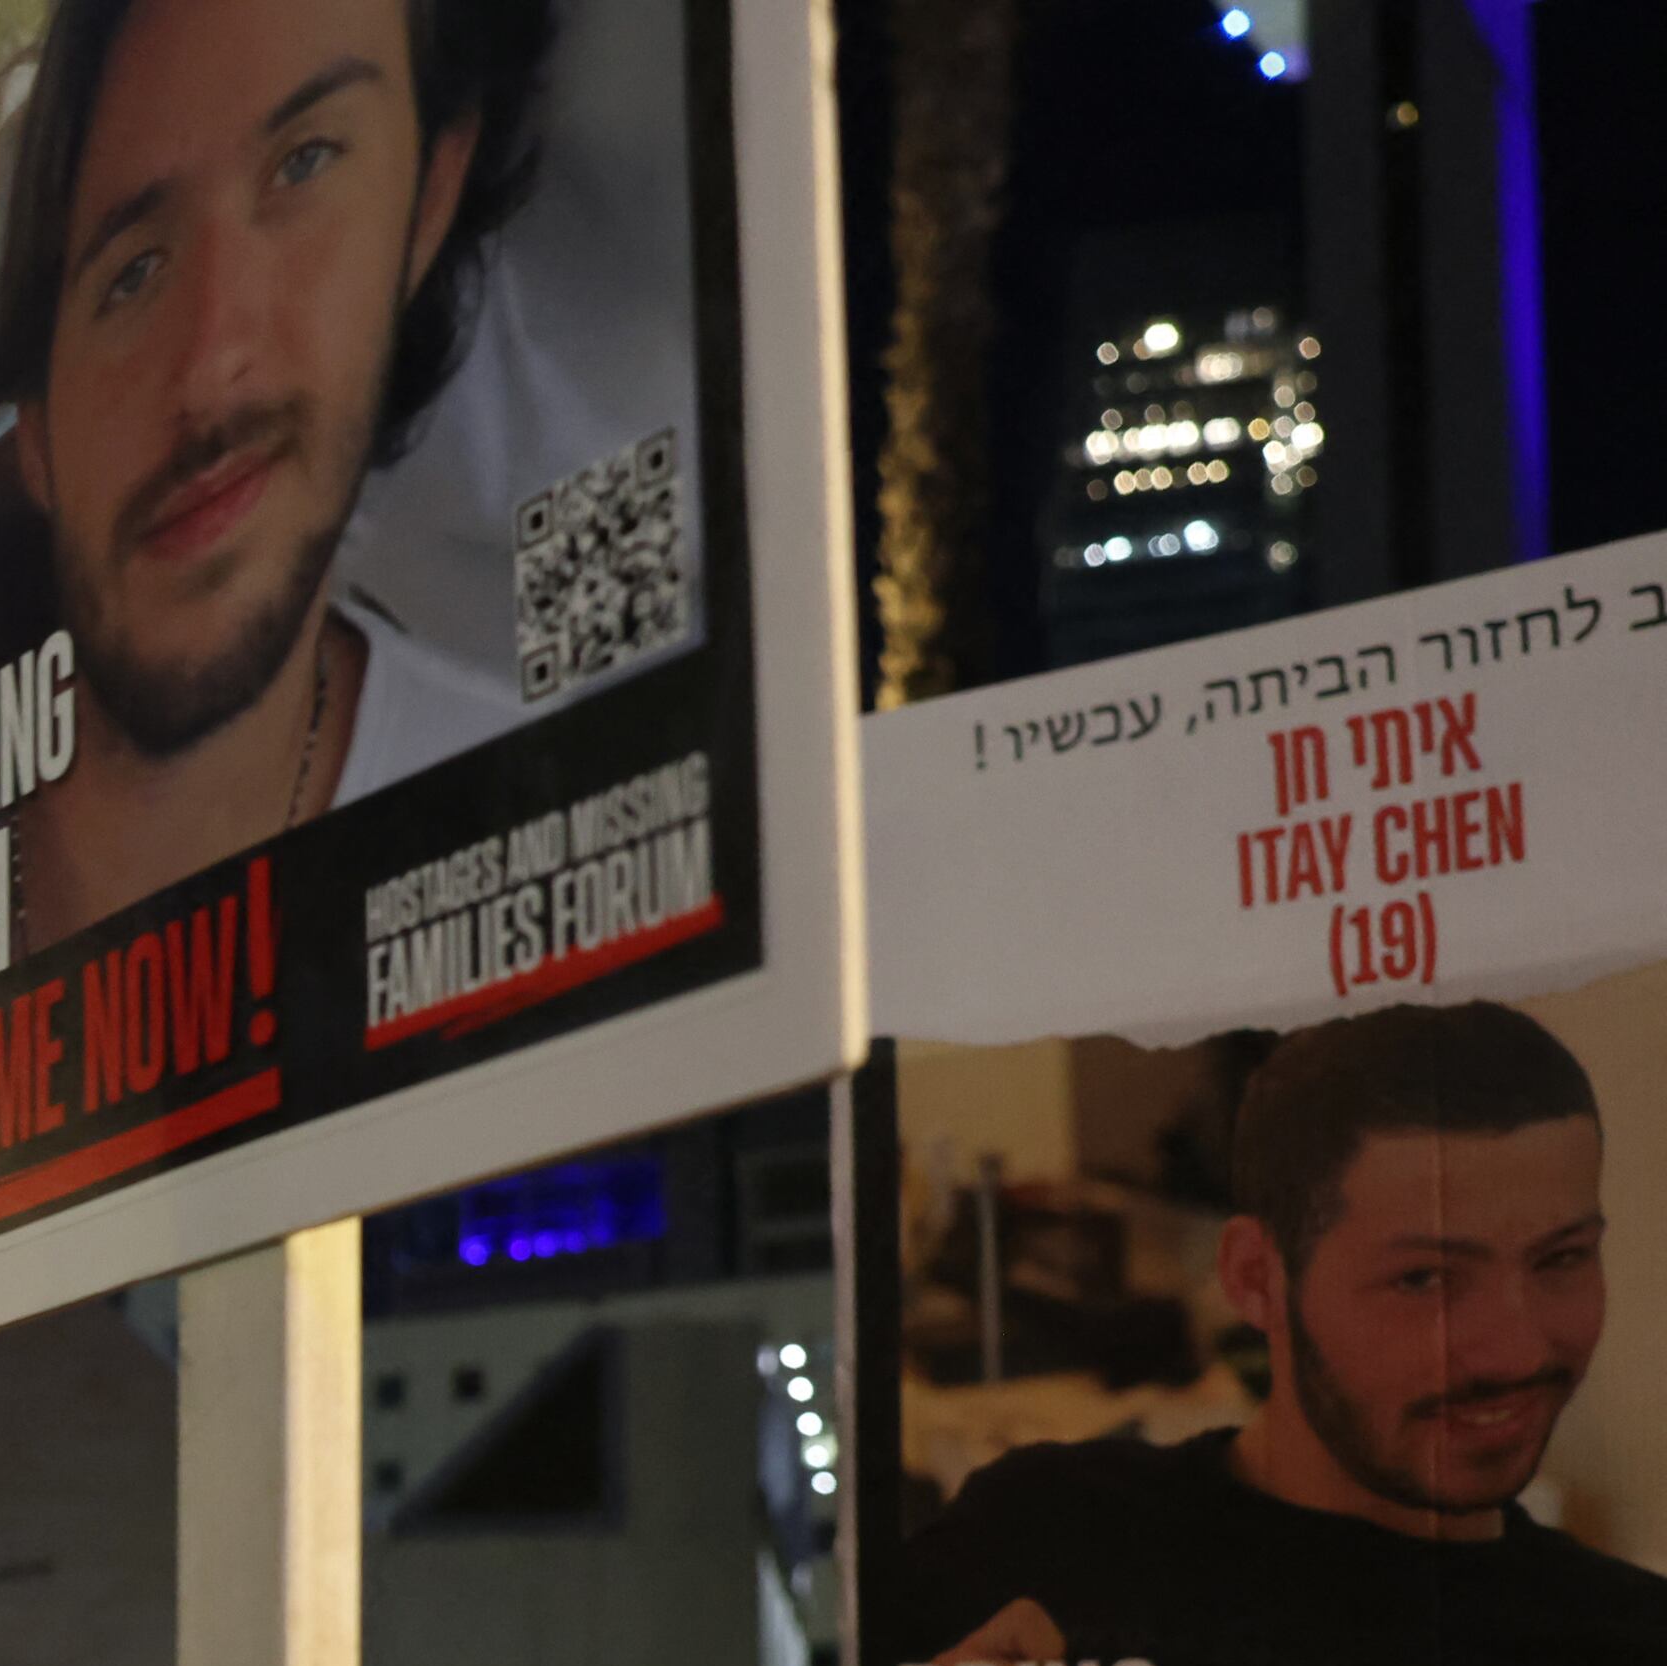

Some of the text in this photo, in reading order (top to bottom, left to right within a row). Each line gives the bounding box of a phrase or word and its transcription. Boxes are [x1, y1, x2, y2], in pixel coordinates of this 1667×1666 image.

[1183, 643, 1397, 735] הביתה,
[1419, 585, 1602, 673] לחזור
[1267, 691, 1482, 818] איתי חן
[365, 750, 710, 946] HOSTAGES AND MISSING
[1236, 781, 1527, 910] ITAY CHEN
[80, 855, 278, 1114] NOW!
[367, 817, 713, 1029] FAMILIES FORUM
[1328, 891, 1438, 998] (19)
